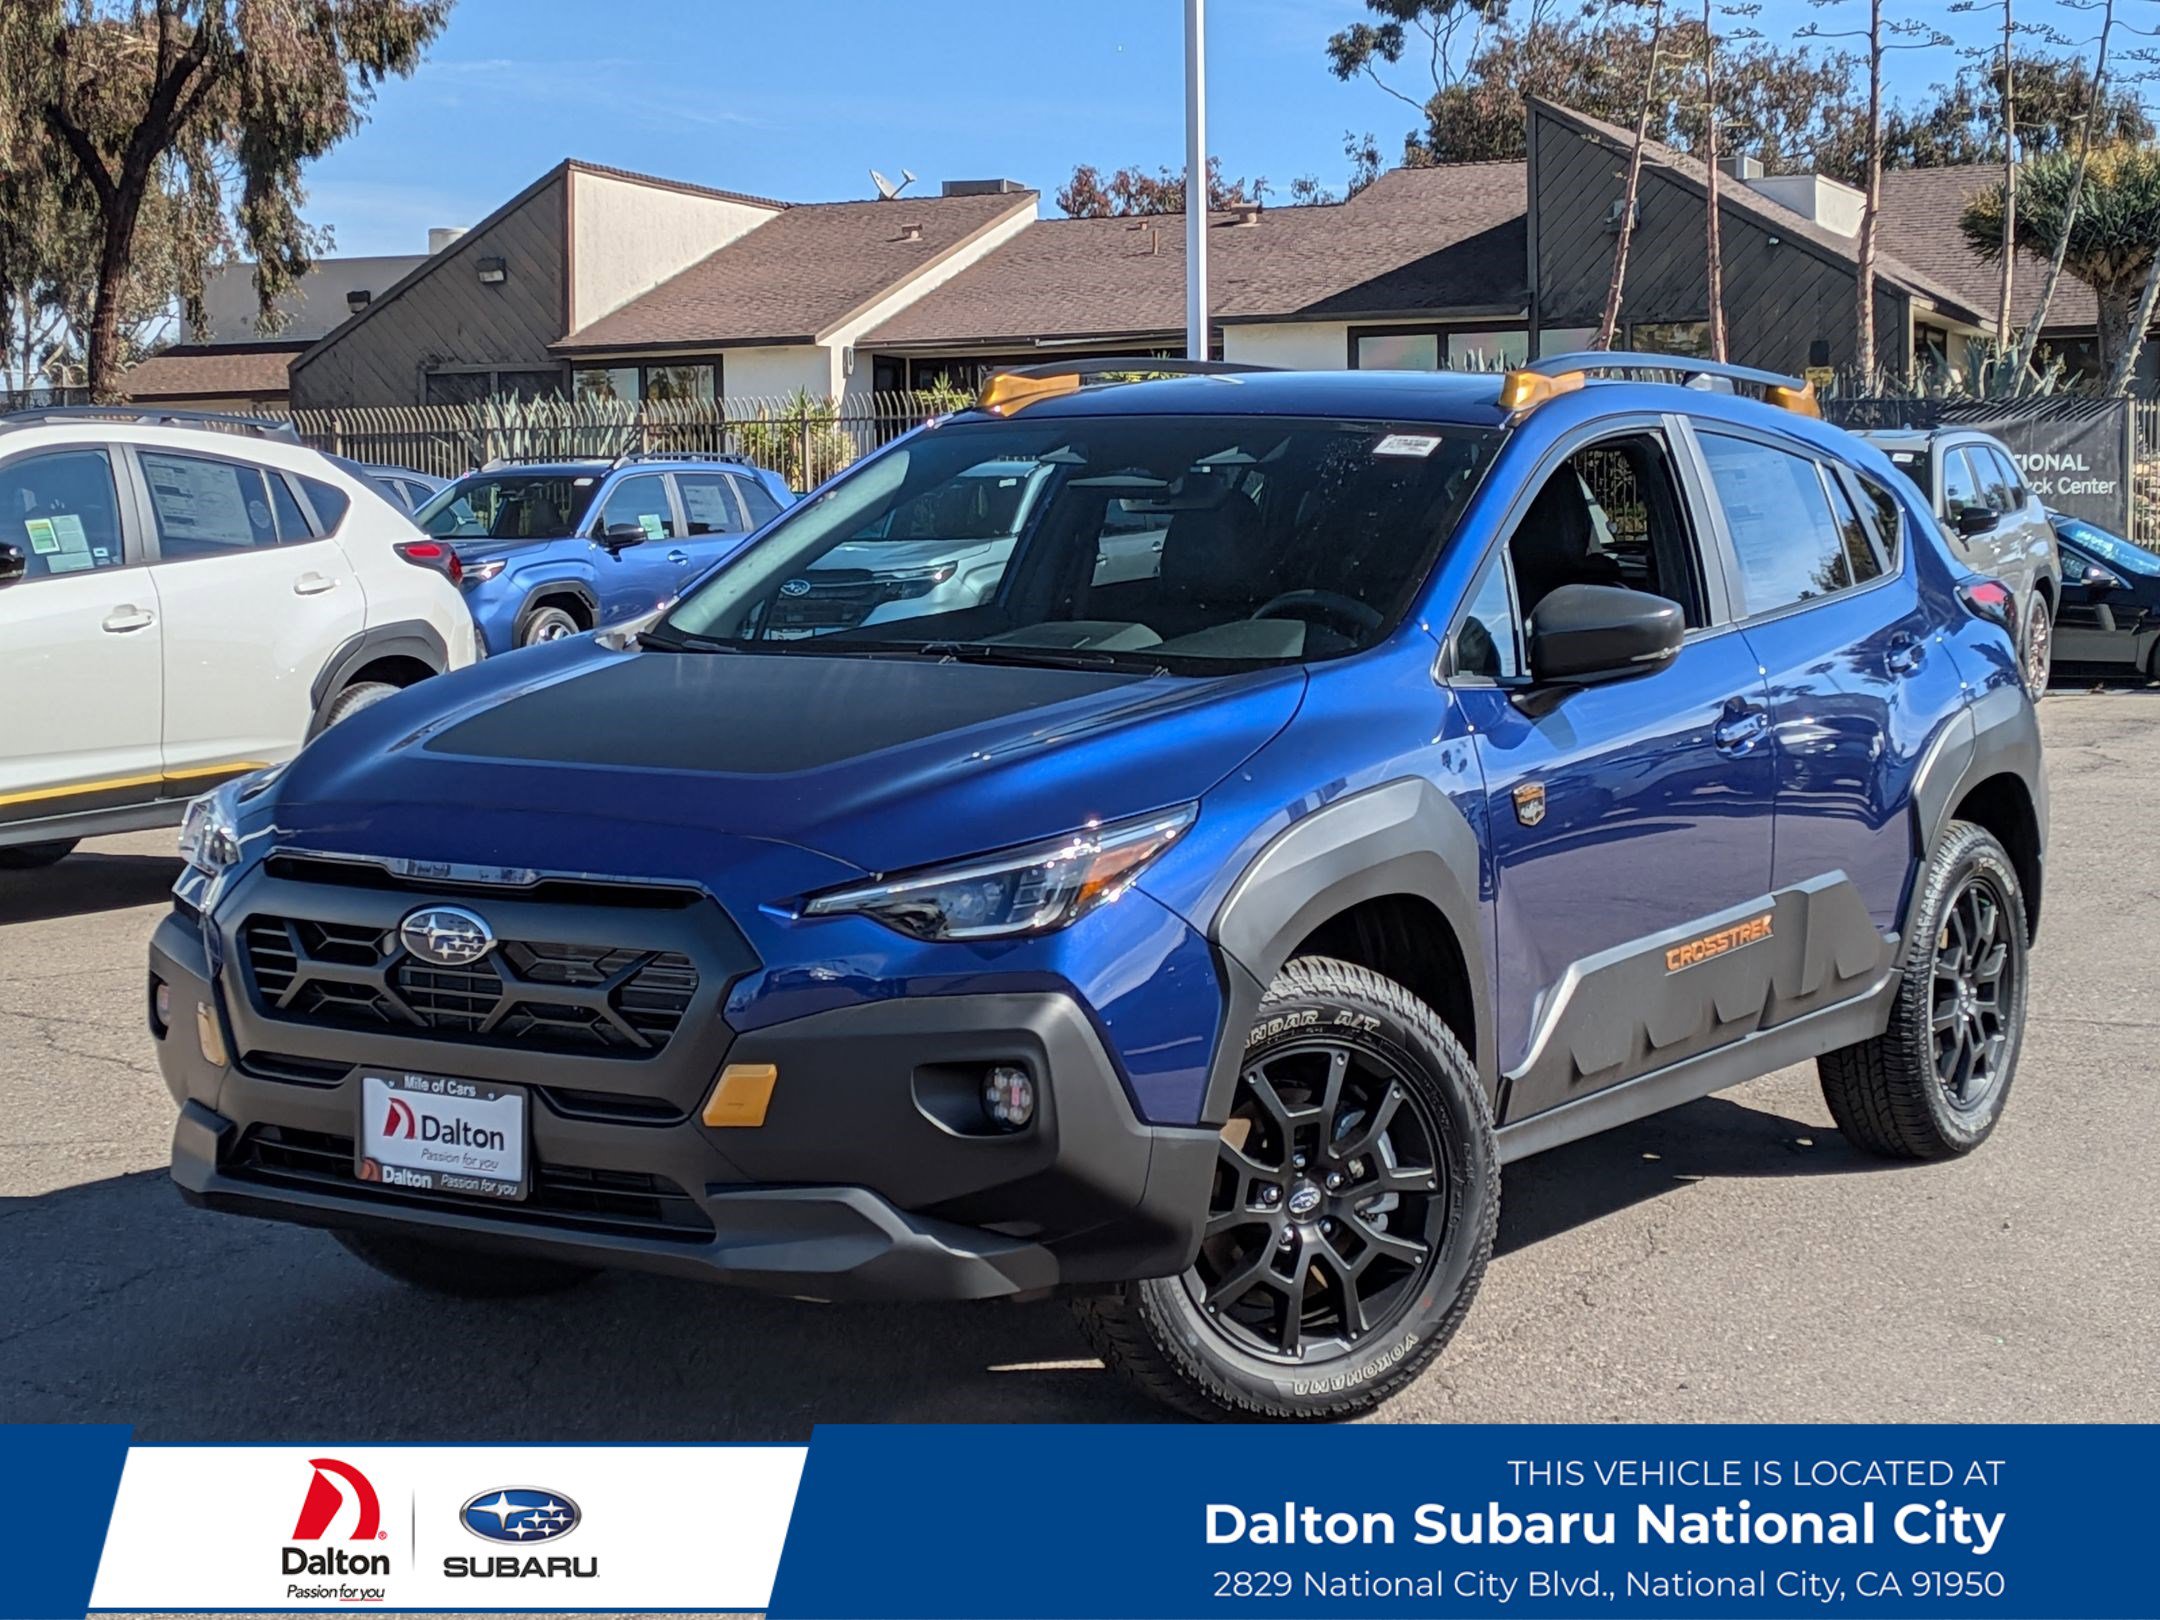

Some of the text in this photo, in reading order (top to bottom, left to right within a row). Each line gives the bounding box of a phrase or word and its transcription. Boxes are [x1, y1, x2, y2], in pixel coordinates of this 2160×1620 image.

[2057, 476, 2118, 495] Center
[1665, 914, 1773, 971] CROSSTREK
[1333, 1010, 1381, 1033] A/T
[404, 1074, 477, 1098] Mile of Cars
[421, 1114, 505, 1151] Dalton
[420, 1148, 500, 1171] Passion for you
[381, 1165, 518, 1197] Dalton Passion for you
[1294, 1332, 1419, 1396] YOKOHAMA
